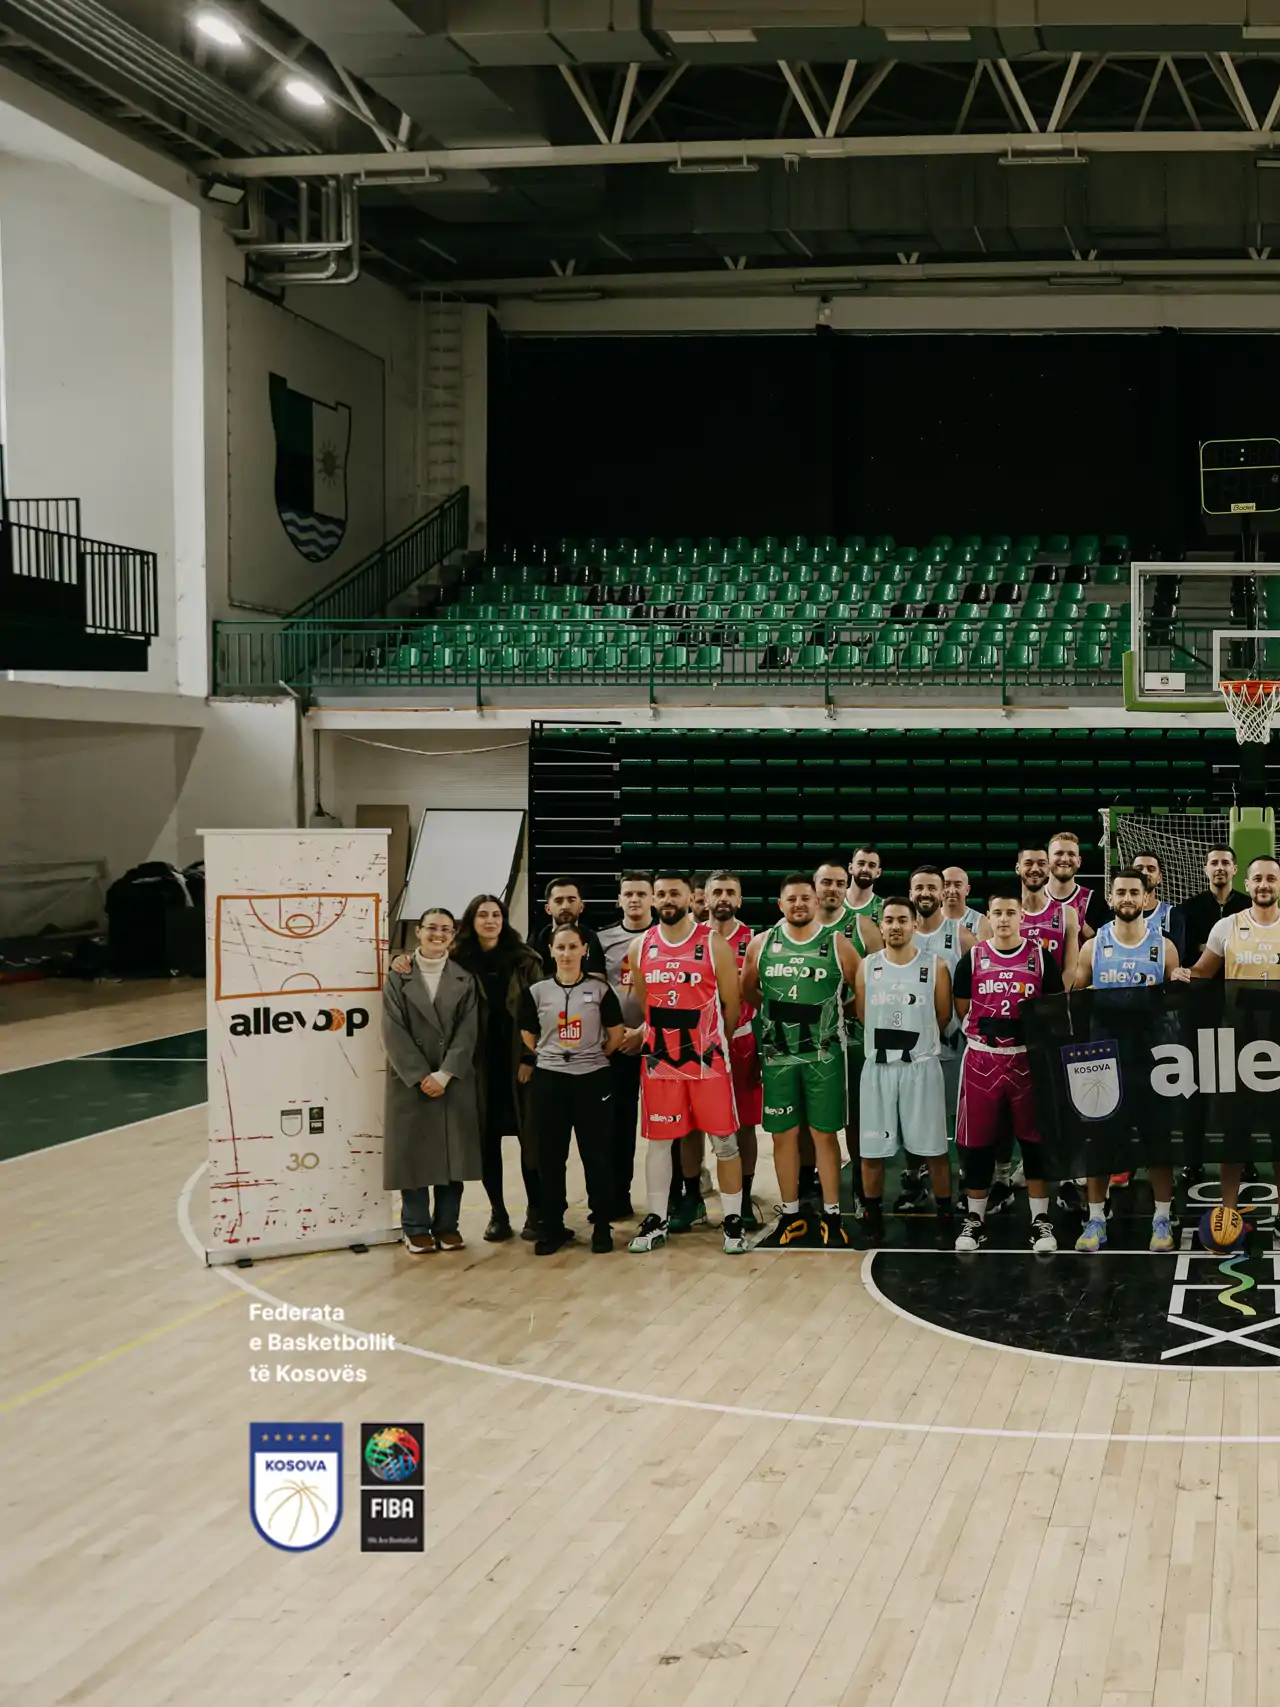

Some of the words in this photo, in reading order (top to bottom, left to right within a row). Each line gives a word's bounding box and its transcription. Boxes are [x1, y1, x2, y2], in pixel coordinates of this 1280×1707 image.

[667, 990, 677, 1006] 3
[788, 984, 798, 1000] 4
[1000, 999, 1011, 1016] 2
[892, 1011, 903, 1028] 3
[1074, 1064, 1111, 1075] KOSOVA
